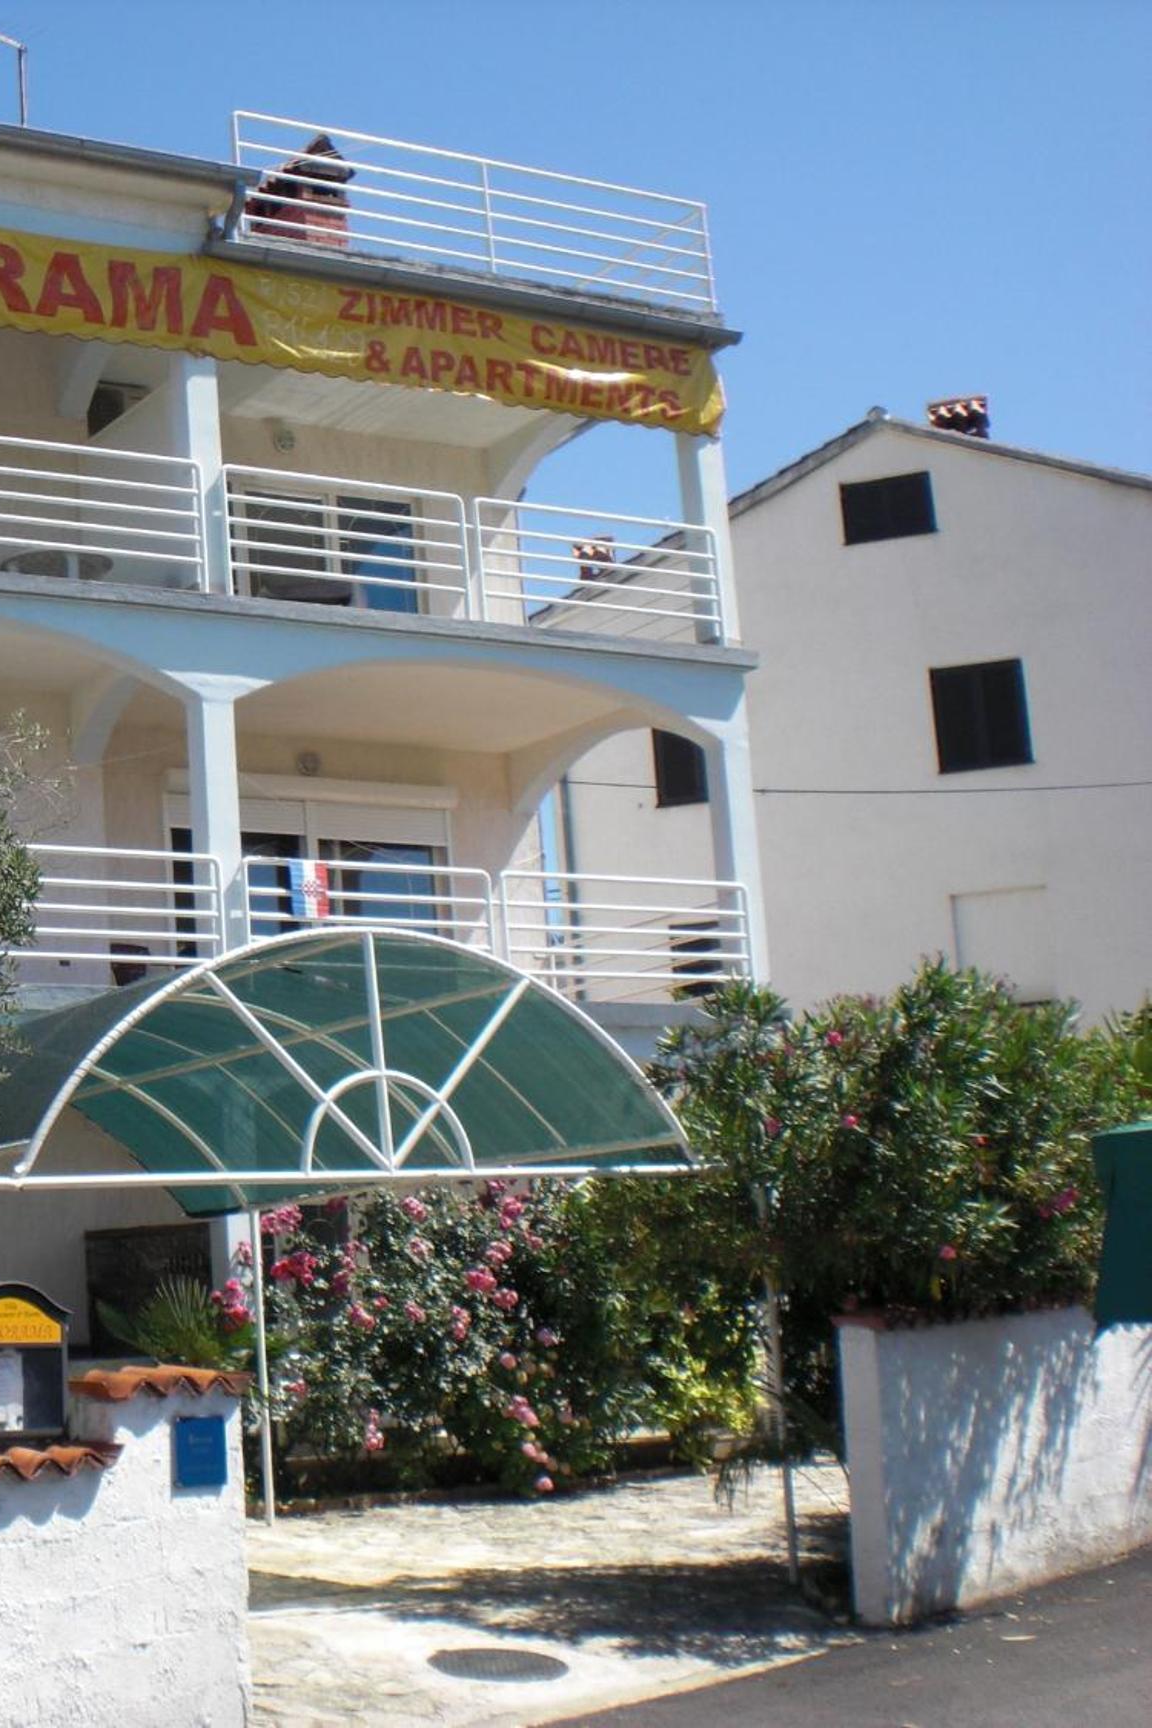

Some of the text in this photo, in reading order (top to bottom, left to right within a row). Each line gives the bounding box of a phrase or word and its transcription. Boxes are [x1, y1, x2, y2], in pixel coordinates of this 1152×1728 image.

[337, 288, 505, 342] ZIMMER
[530, 325, 691, 376] CAMERE
[364, 341, 685, 420] & APARTMENTS
